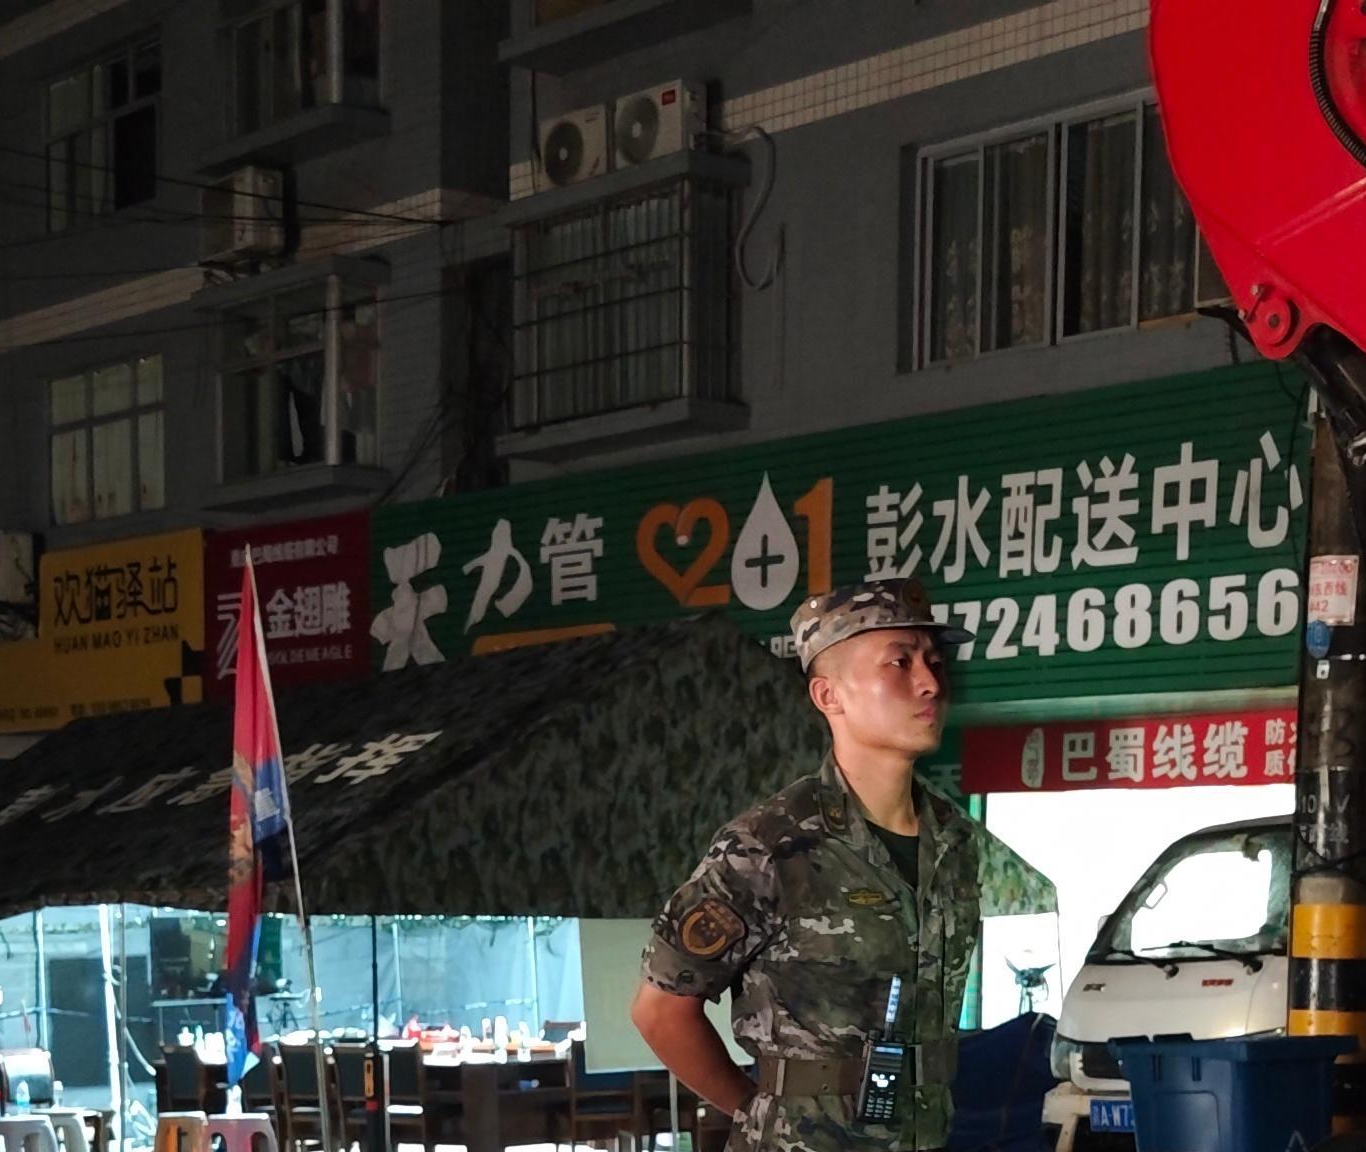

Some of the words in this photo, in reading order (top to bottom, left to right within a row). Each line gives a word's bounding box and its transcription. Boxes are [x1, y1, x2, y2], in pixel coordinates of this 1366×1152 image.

[865, 429, 1302, 583] 彭水配送中心
[54, 555, 179, 626] 欢猫驿站
[54, 636, 88, 653] HUAN
[92, 631, 122, 649] MAO
[144, 624, 179, 645] ZHAN
[1061, 720, 1250, 782] 巴蜀线缆
